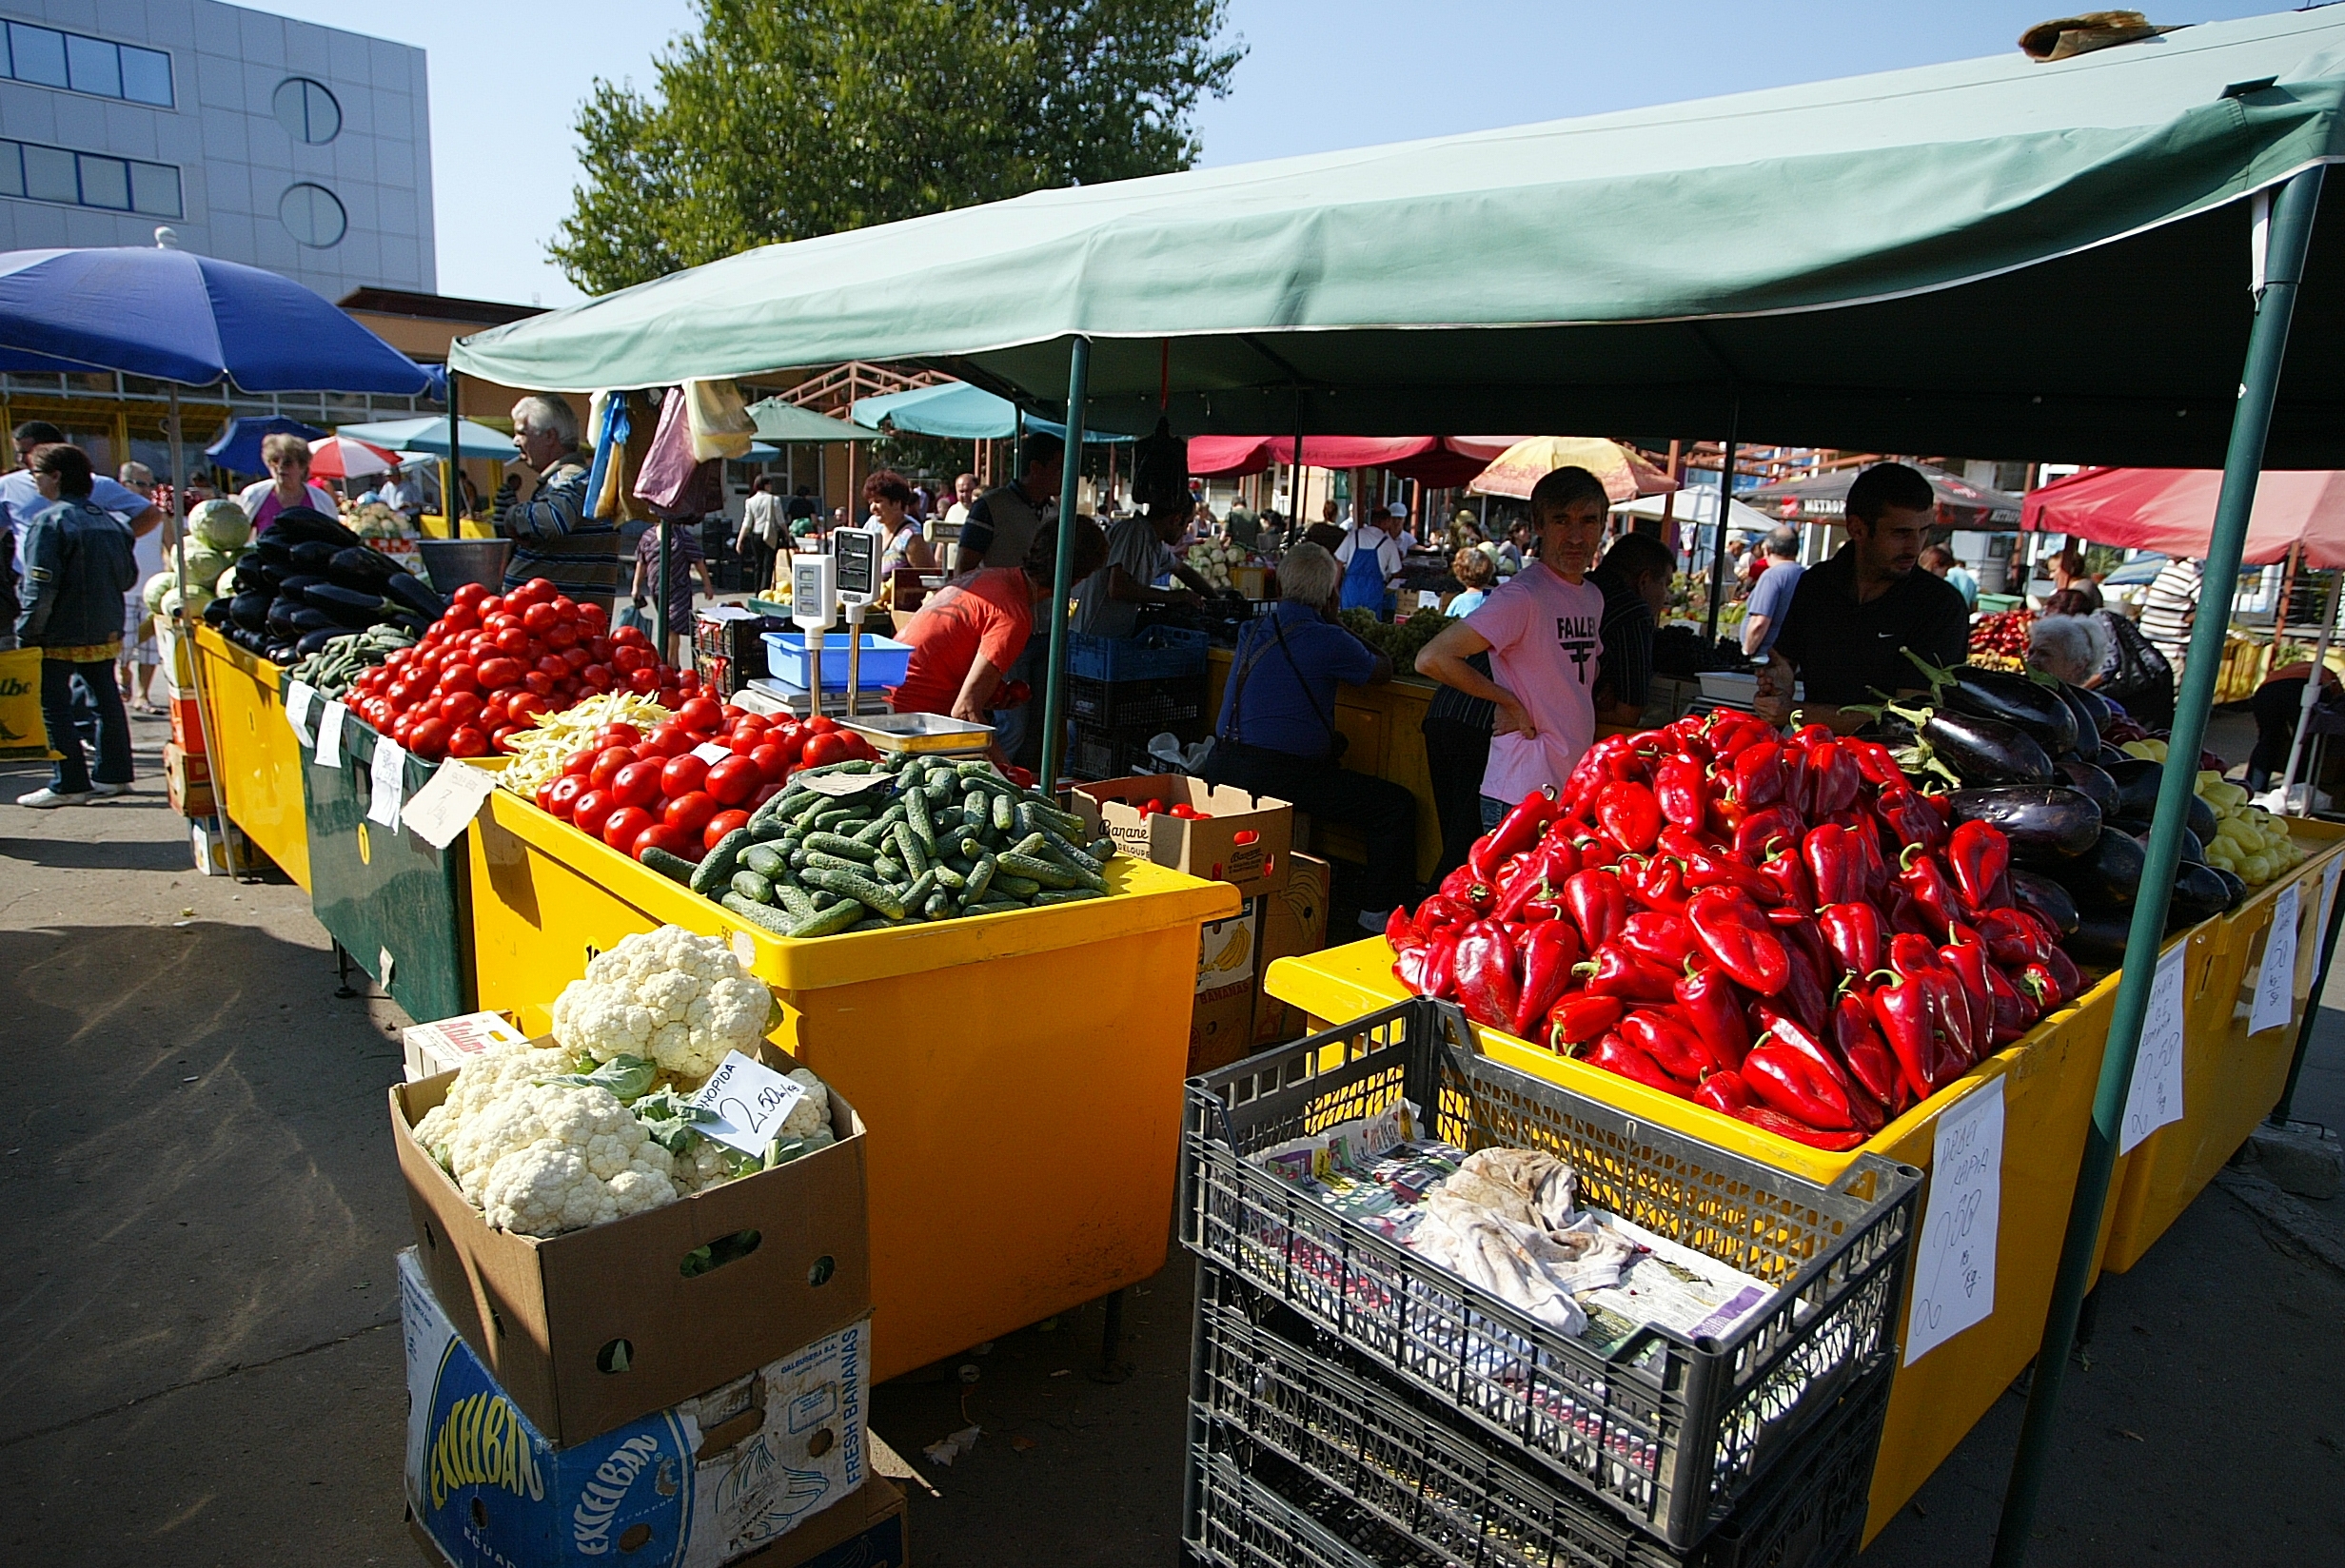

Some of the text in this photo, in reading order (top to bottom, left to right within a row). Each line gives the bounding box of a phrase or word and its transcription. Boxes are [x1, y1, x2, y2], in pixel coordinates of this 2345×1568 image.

[0, 677, 32, 696] lbo
[1097, 818, 1150, 839] Banane
[1200, 982, 1250, 1005] BANANAS
[840, 1327, 862, 1486] FRESH BANANAS
[573, 1434, 659, 1555] EXCELBAN
